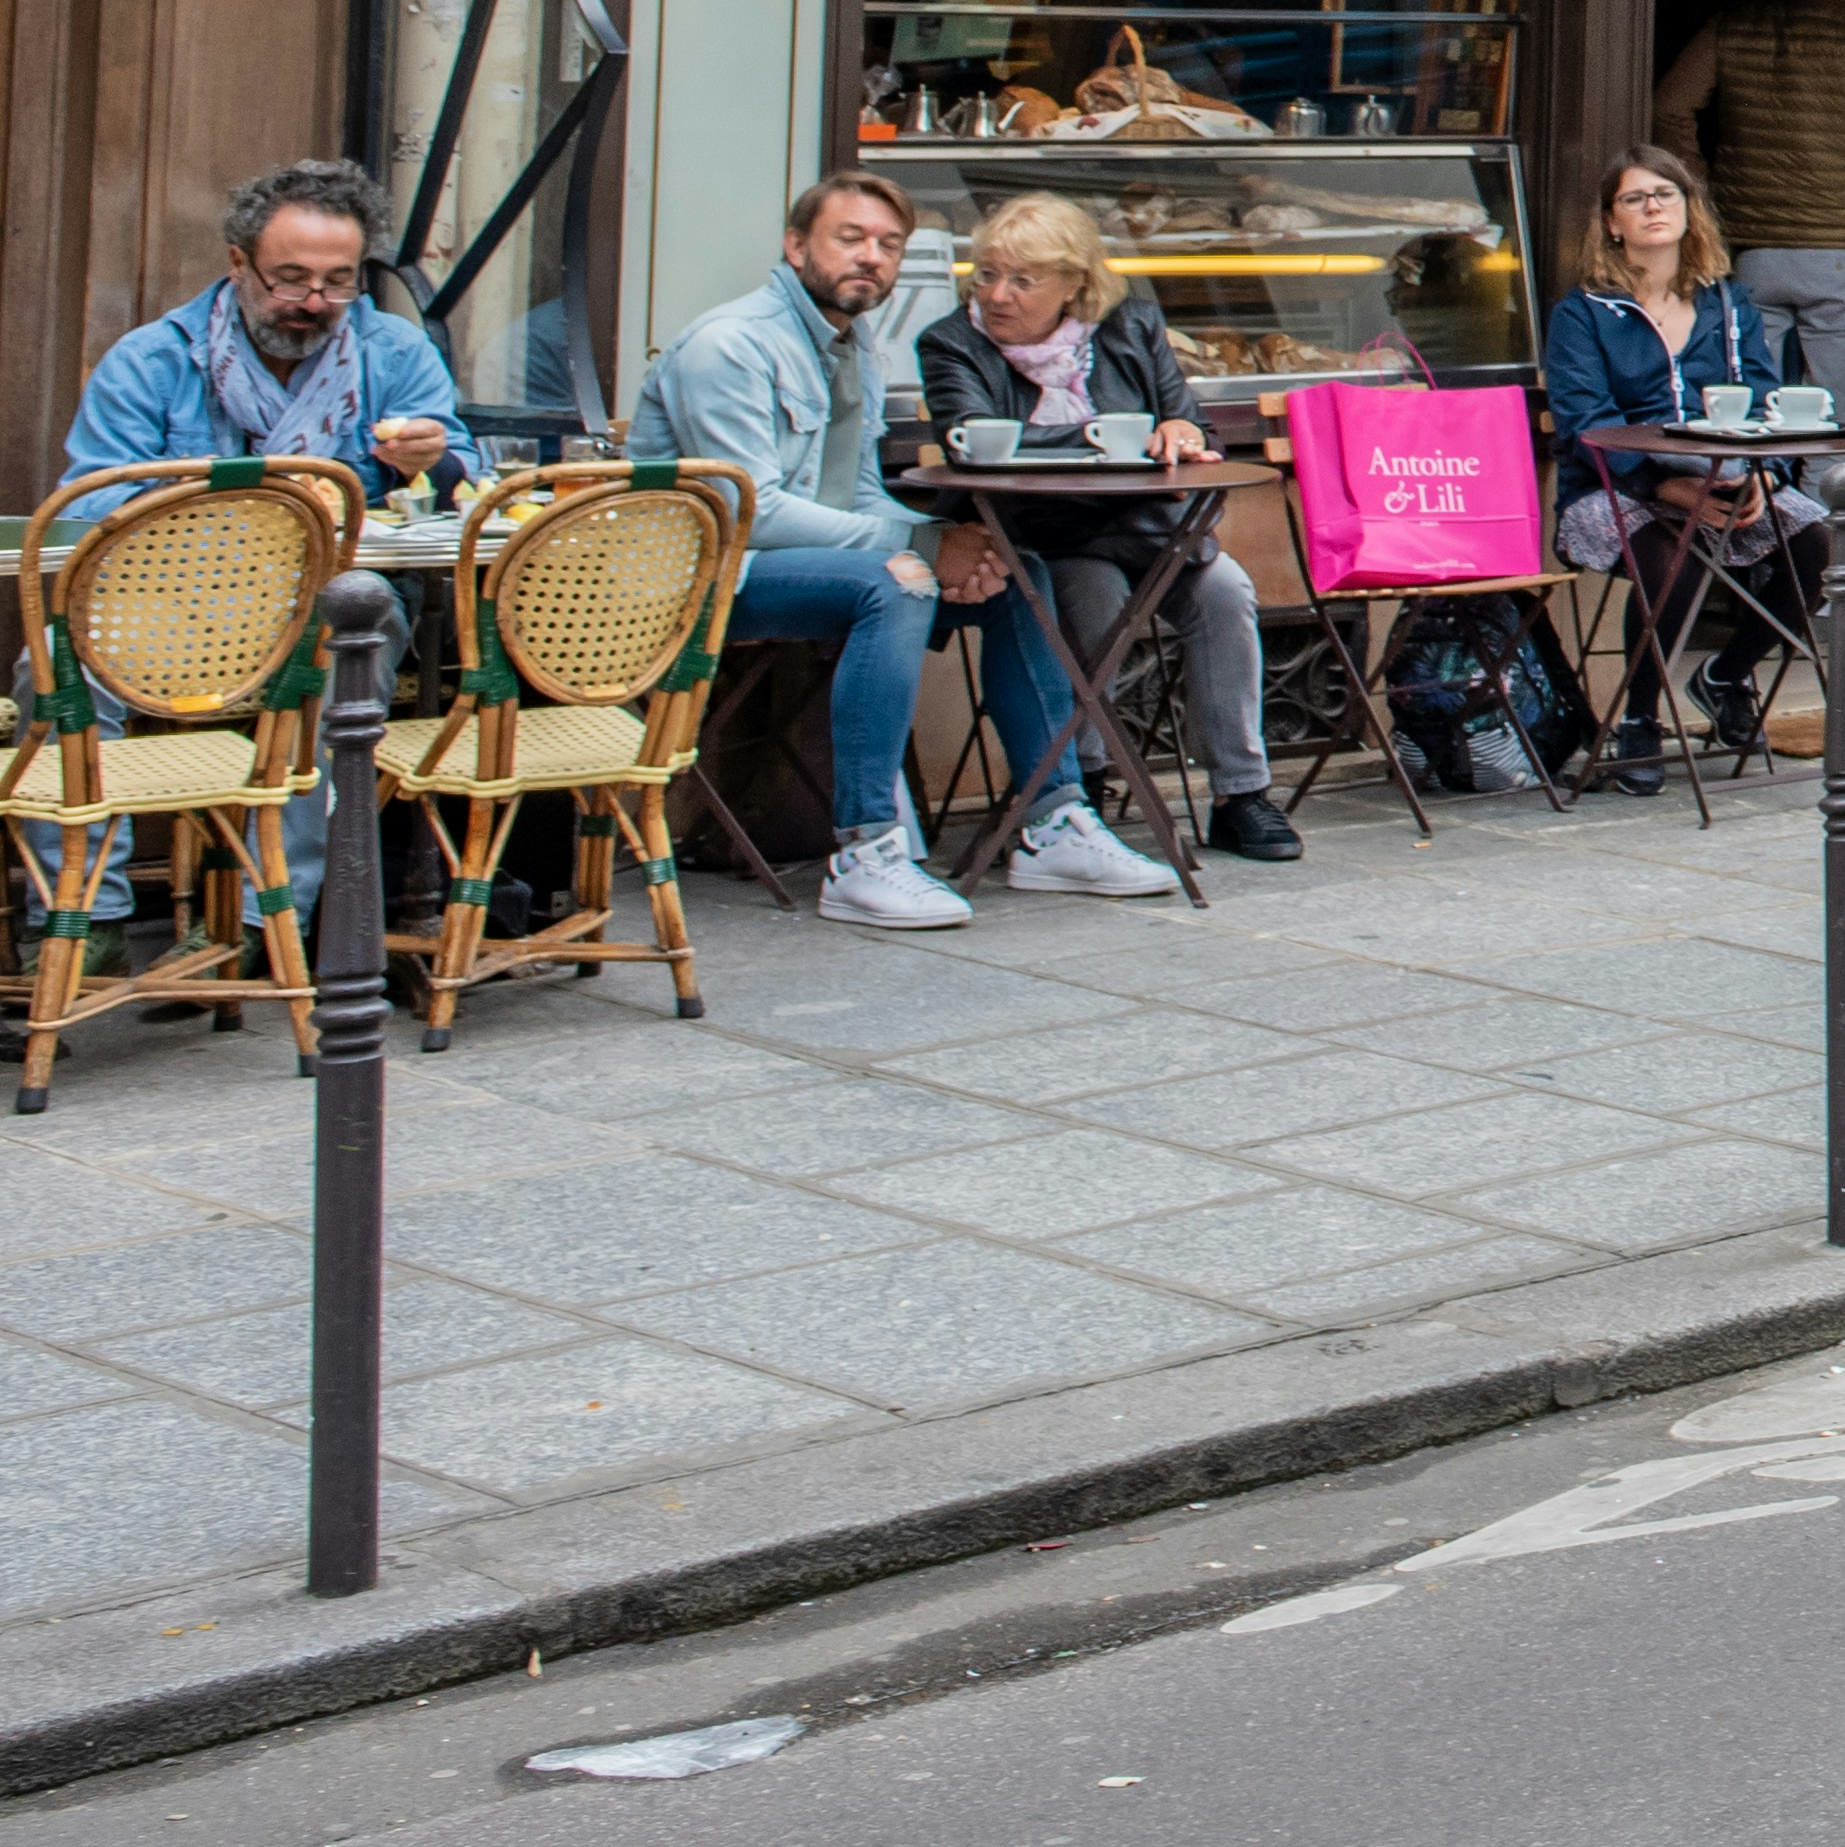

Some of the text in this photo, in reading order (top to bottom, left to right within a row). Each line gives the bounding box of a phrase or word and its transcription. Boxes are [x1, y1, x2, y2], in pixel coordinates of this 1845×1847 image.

[1368, 446, 1481, 477] Antoine
[1384, 480, 1467, 514] & Lili
